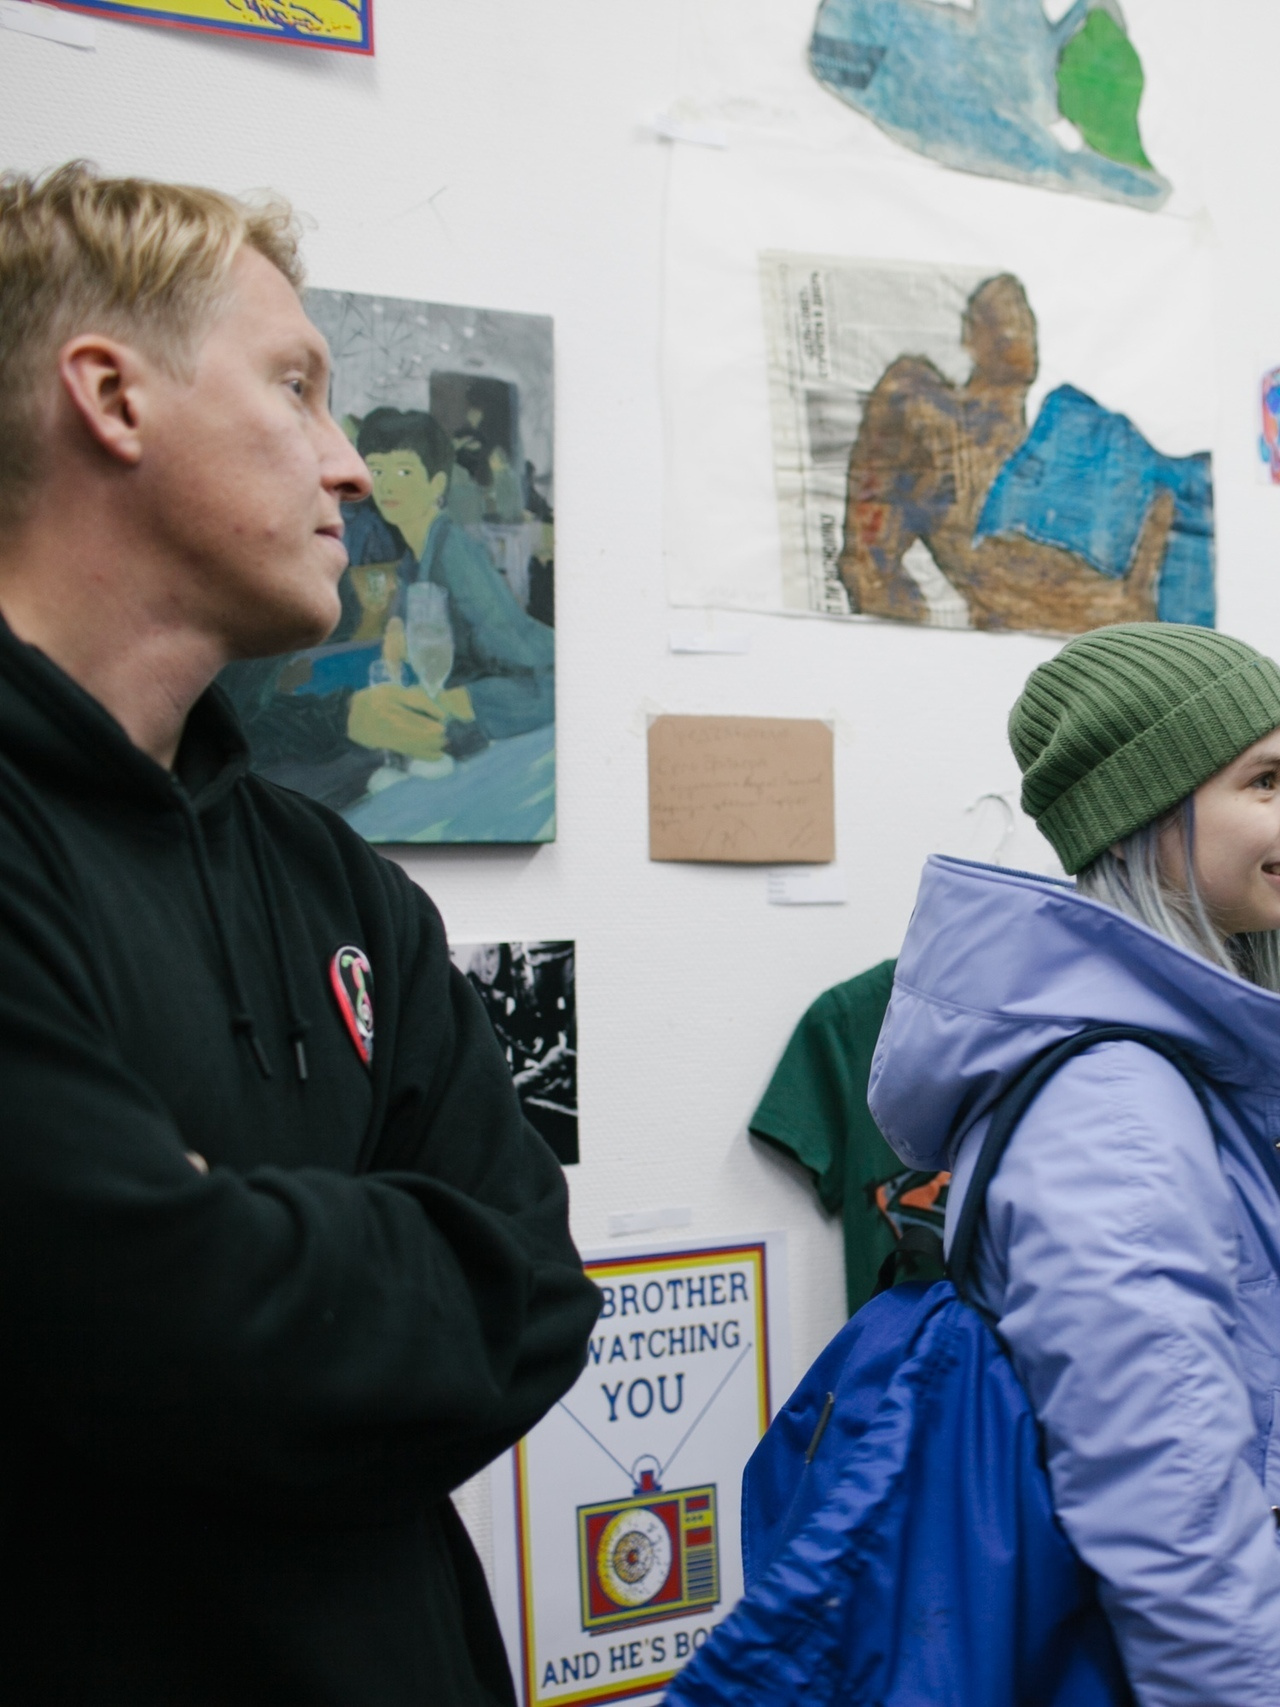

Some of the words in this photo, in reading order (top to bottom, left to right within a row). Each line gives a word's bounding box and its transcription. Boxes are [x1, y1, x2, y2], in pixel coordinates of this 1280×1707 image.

[599, 1271, 749, 1320] BROTHER
[601, 1372, 685, 1422] YOU
[542, 1651, 600, 1689] AND
[609, 1636, 666, 1674] HE'S
[674, 1625, 717, 1659] BO
